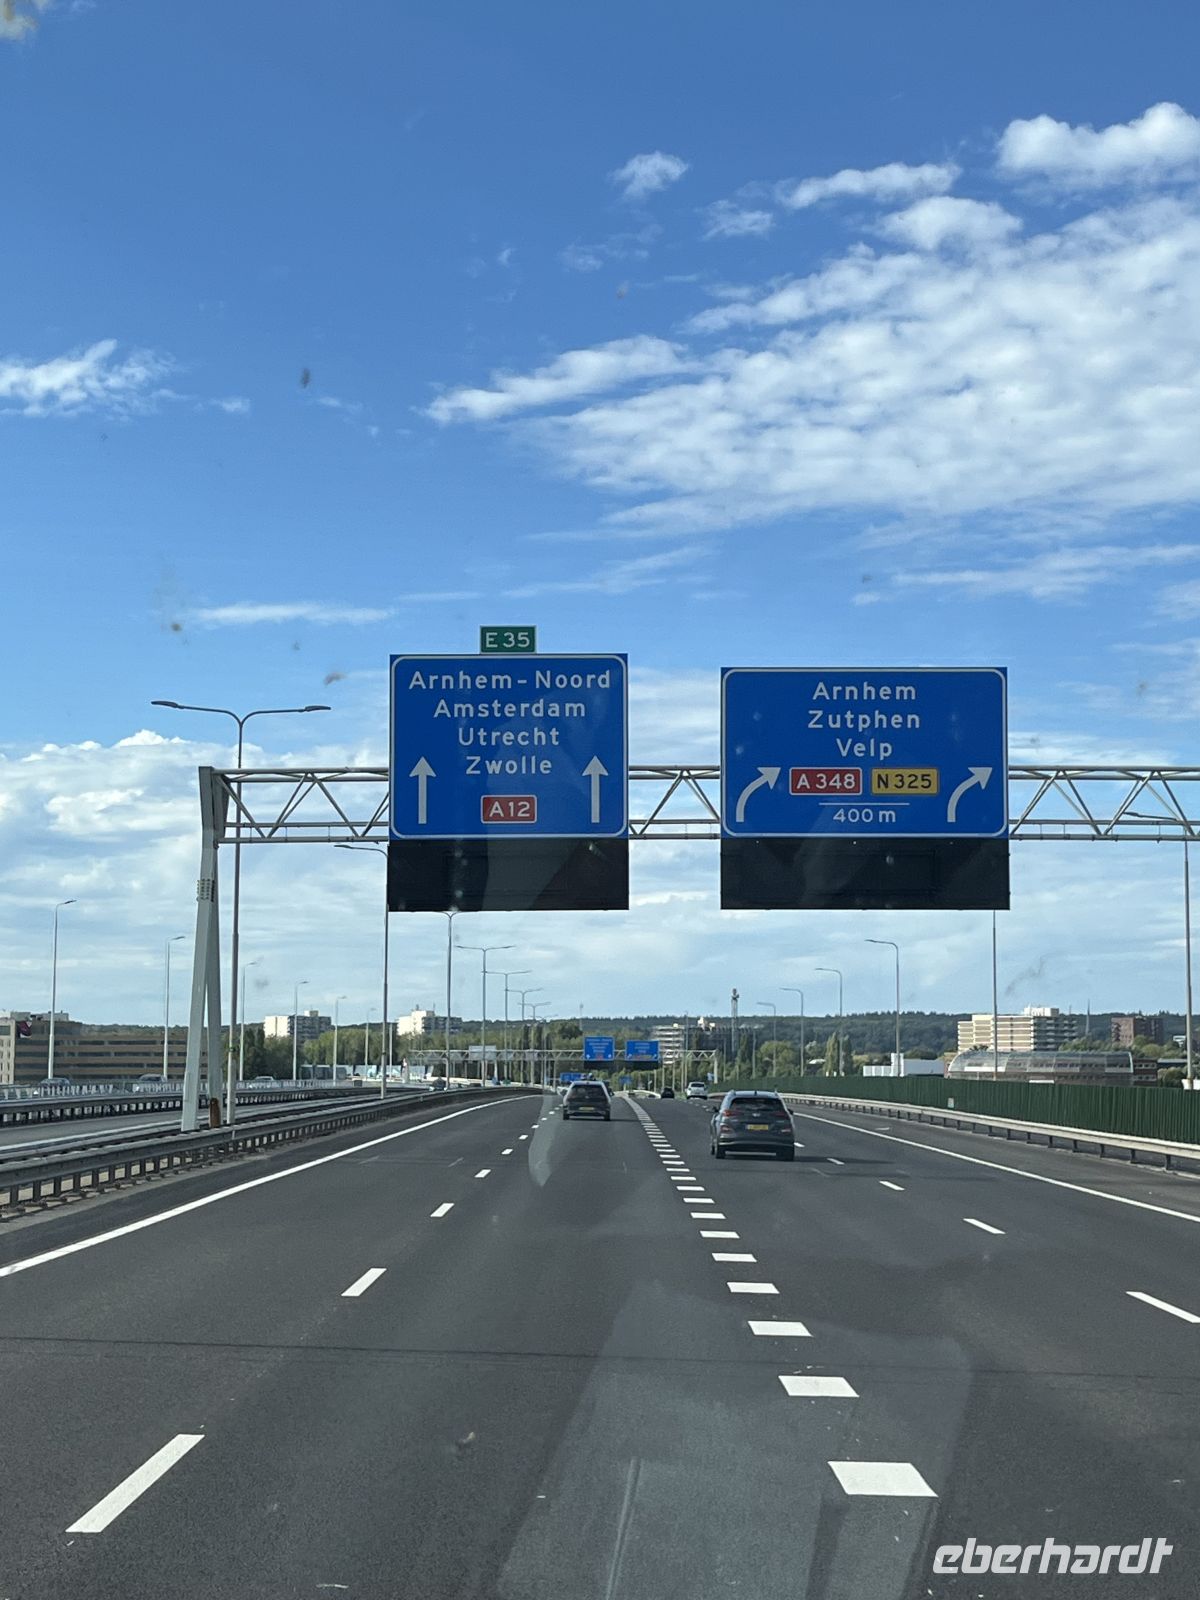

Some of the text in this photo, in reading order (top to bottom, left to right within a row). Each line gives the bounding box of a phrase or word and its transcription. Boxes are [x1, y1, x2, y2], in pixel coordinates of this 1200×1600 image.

[503, 632, 530, 648] 35
[812, 681, 917, 701] Arnhem
[433, 698, 586, 718] Amsterdam
[808, 709, 920, 732] Zutphen
[458, 727, 559, 746] Utrecht
[836, 738, 893, 760] Velp
[465, 755, 552, 775] Zwolle
[832, 808, 896, 823] 400 m
